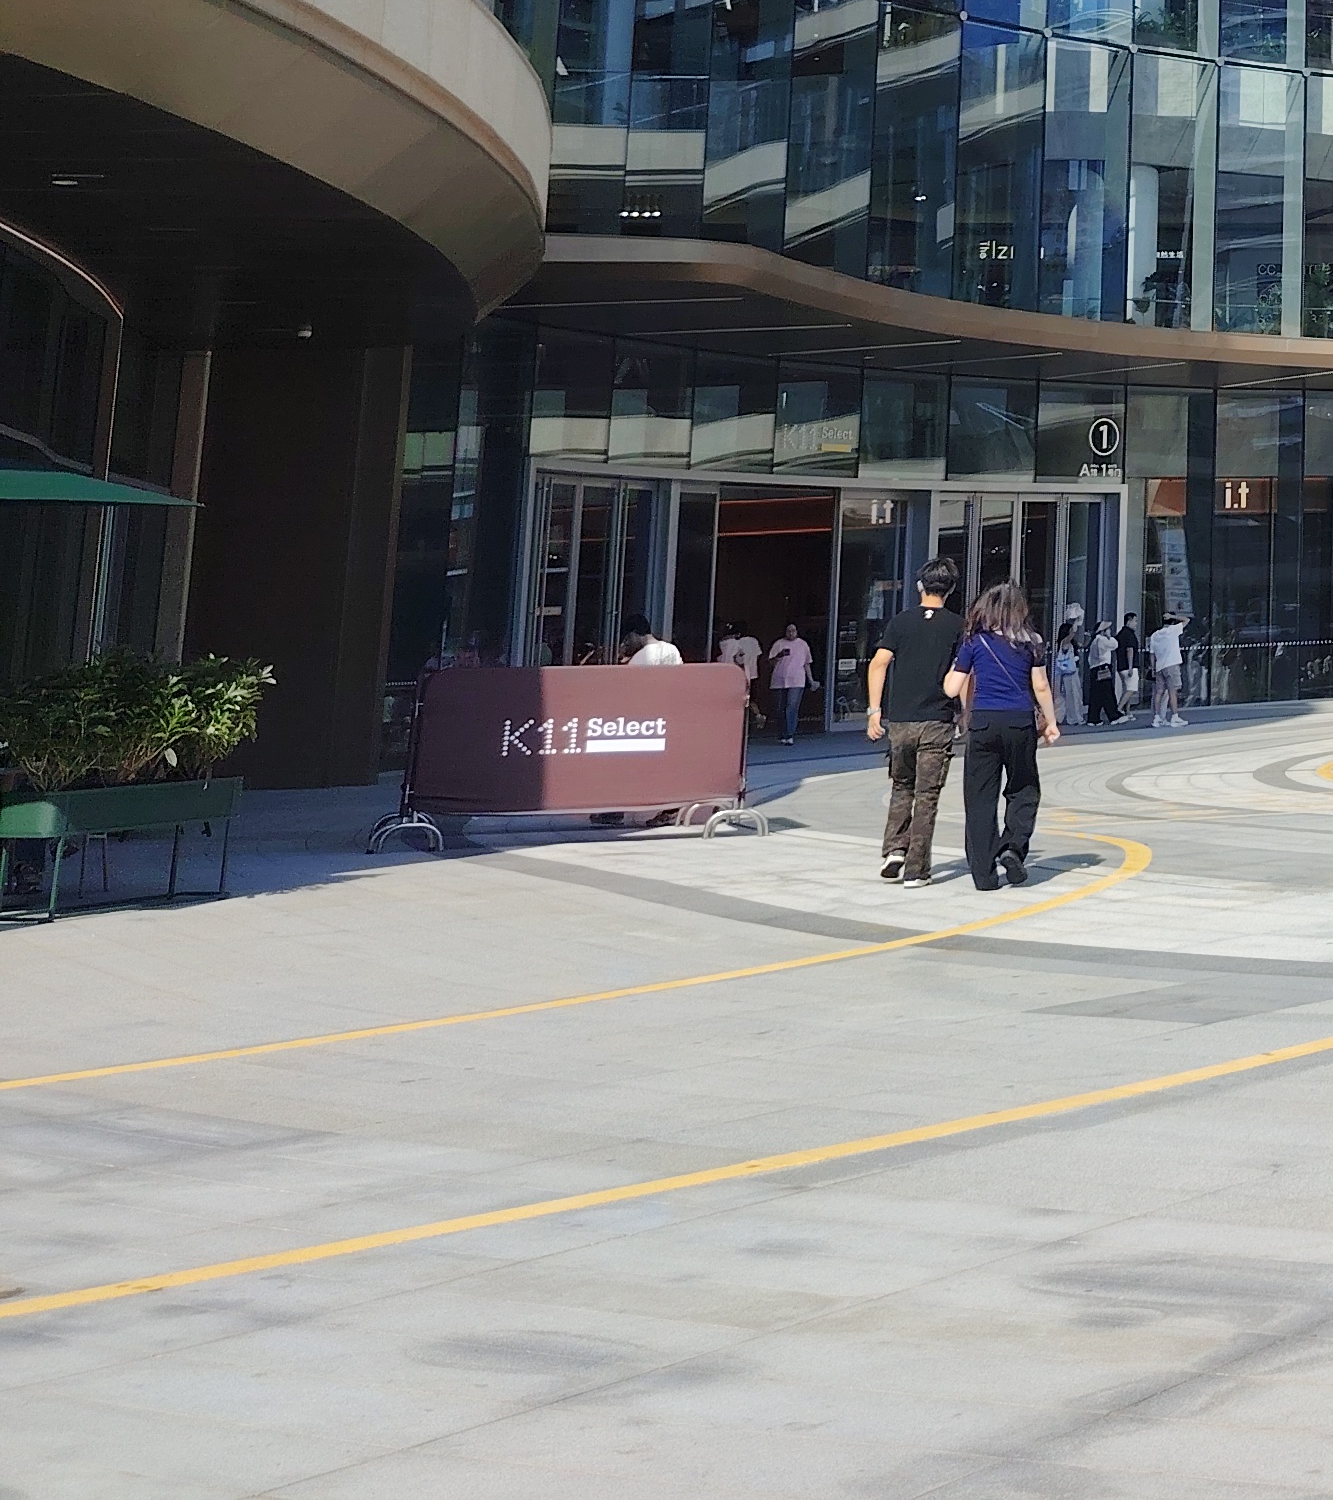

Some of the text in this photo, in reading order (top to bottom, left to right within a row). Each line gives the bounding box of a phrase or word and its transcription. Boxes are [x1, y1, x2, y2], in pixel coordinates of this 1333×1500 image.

[821, 426, 854, 441] Select
[1225, 481, 1250, 509] i.t
[501, 716, 667, 757] K11 Select
